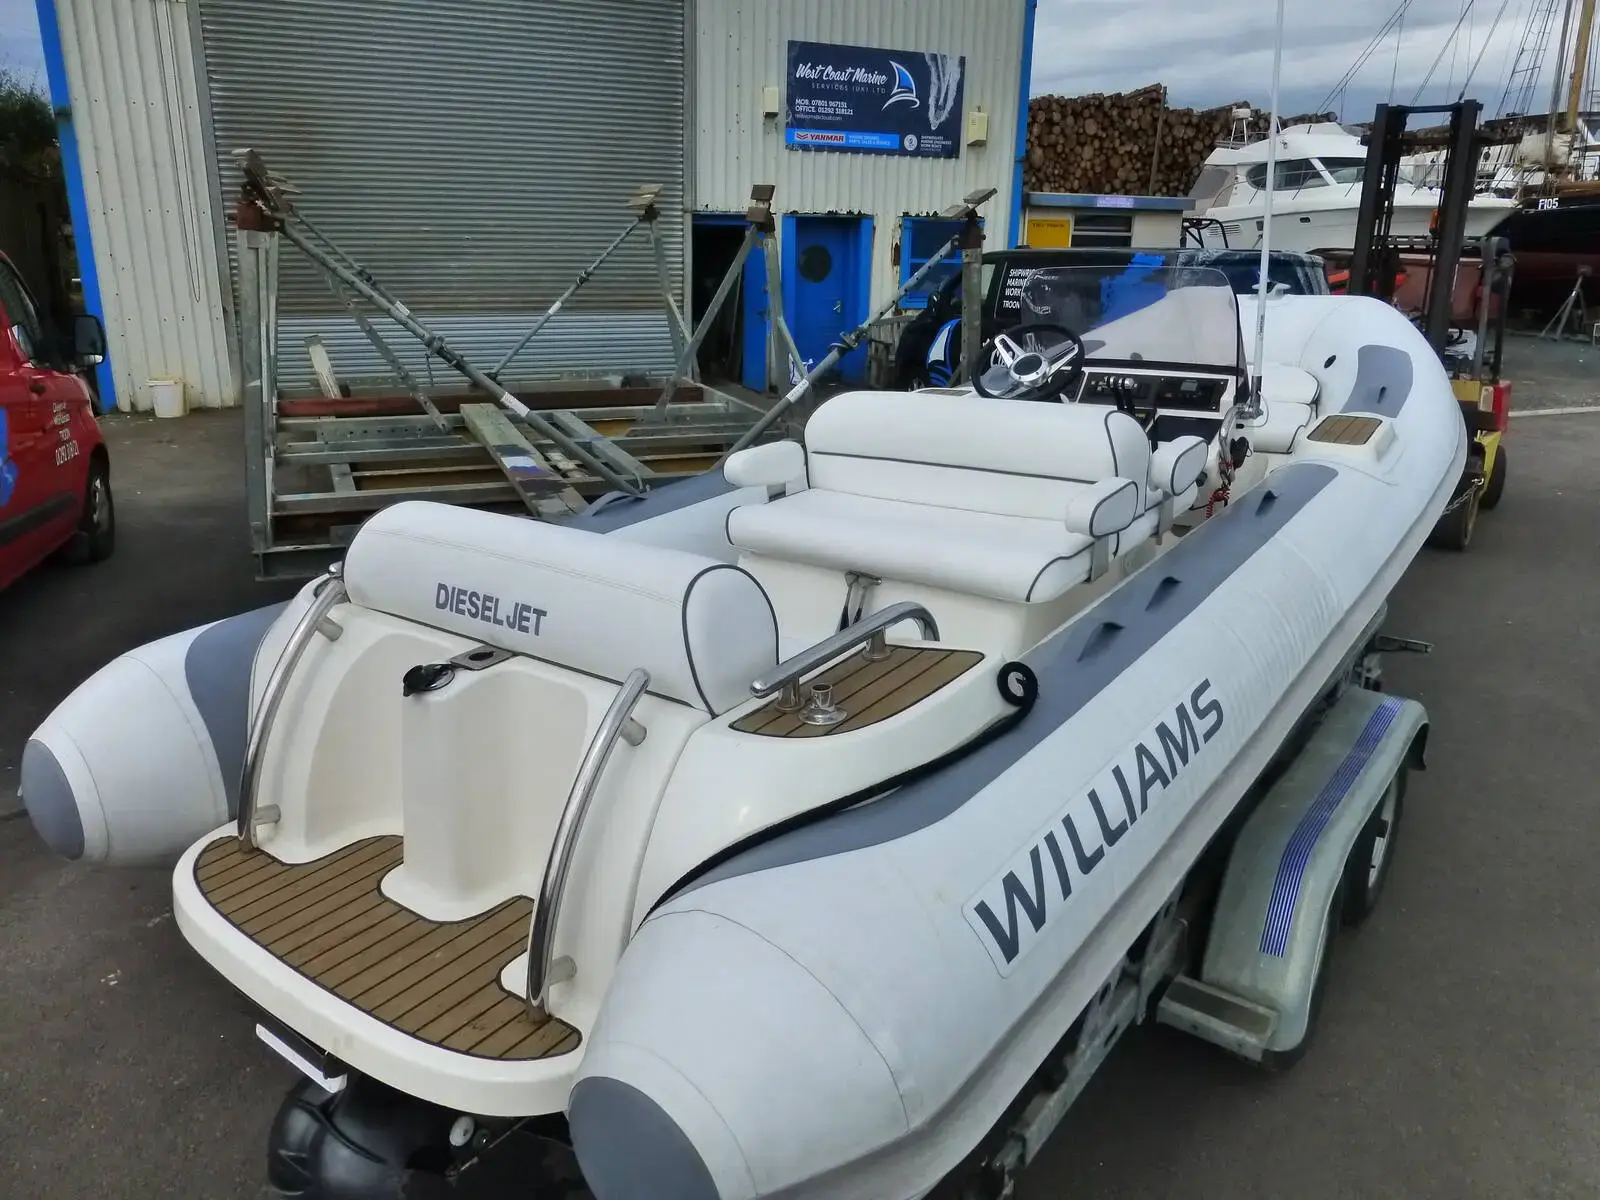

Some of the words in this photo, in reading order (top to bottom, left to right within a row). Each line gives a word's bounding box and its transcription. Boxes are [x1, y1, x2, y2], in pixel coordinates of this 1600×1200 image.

[796, 63, 825, 79] West
[822, 65, 855, 82] Coast
[852, 68, 888, 85] Marine
[811, 82, 848, 92] SERVICES
[810, 133, 844, 142] YANMAR
[1005, 287, 1021, 296] WORK
[1003, 300, 1020, 309] TROON
[973, 678, 1224, 965] WILLIAMS
